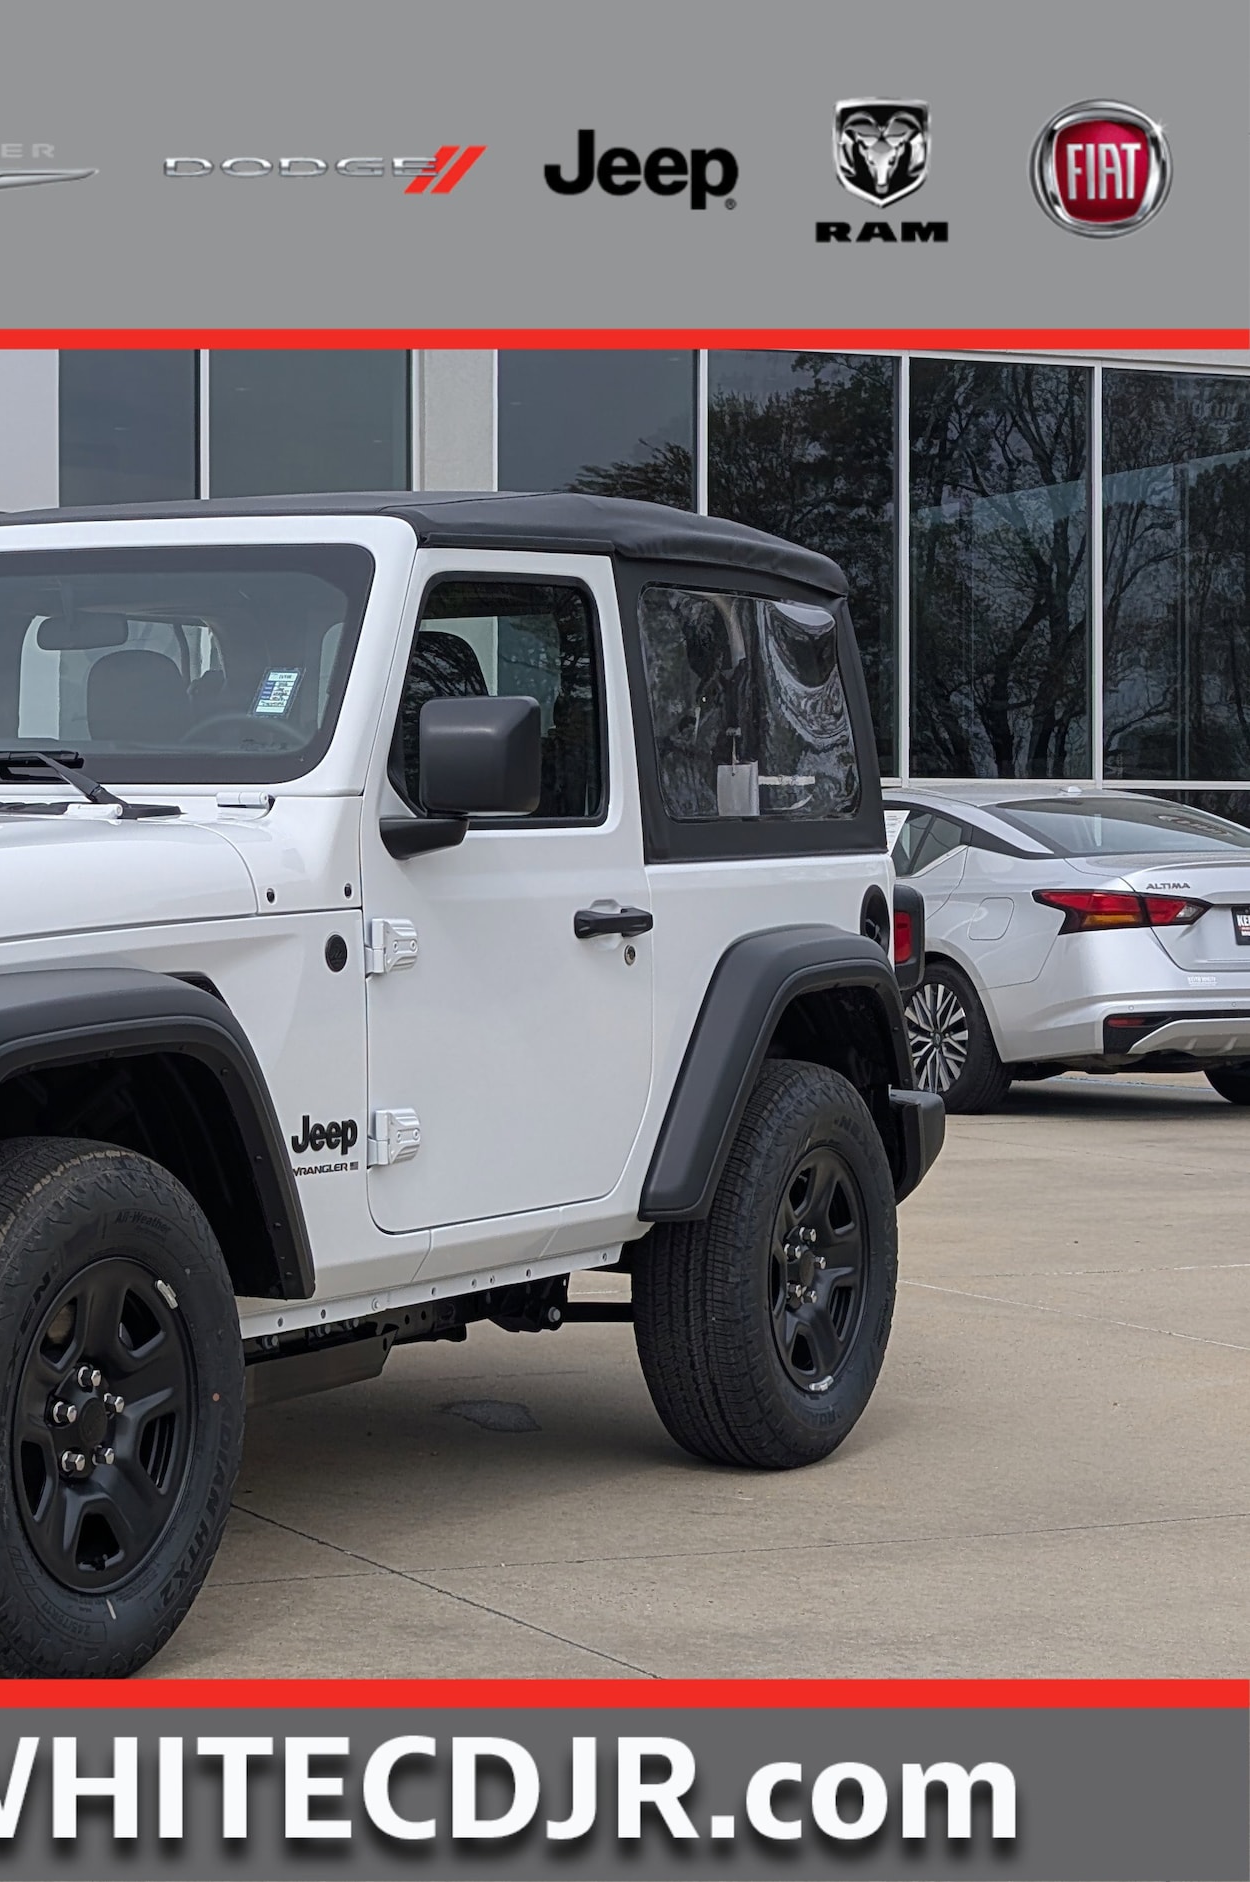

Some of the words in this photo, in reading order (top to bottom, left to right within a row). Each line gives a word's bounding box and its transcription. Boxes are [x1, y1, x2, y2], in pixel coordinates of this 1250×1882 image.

[1146, 882, 1191, 890] ALTIMA
[291, 1115, 358, 1156] Jeep
[114, 1211, 173, 1232] All-Weather
